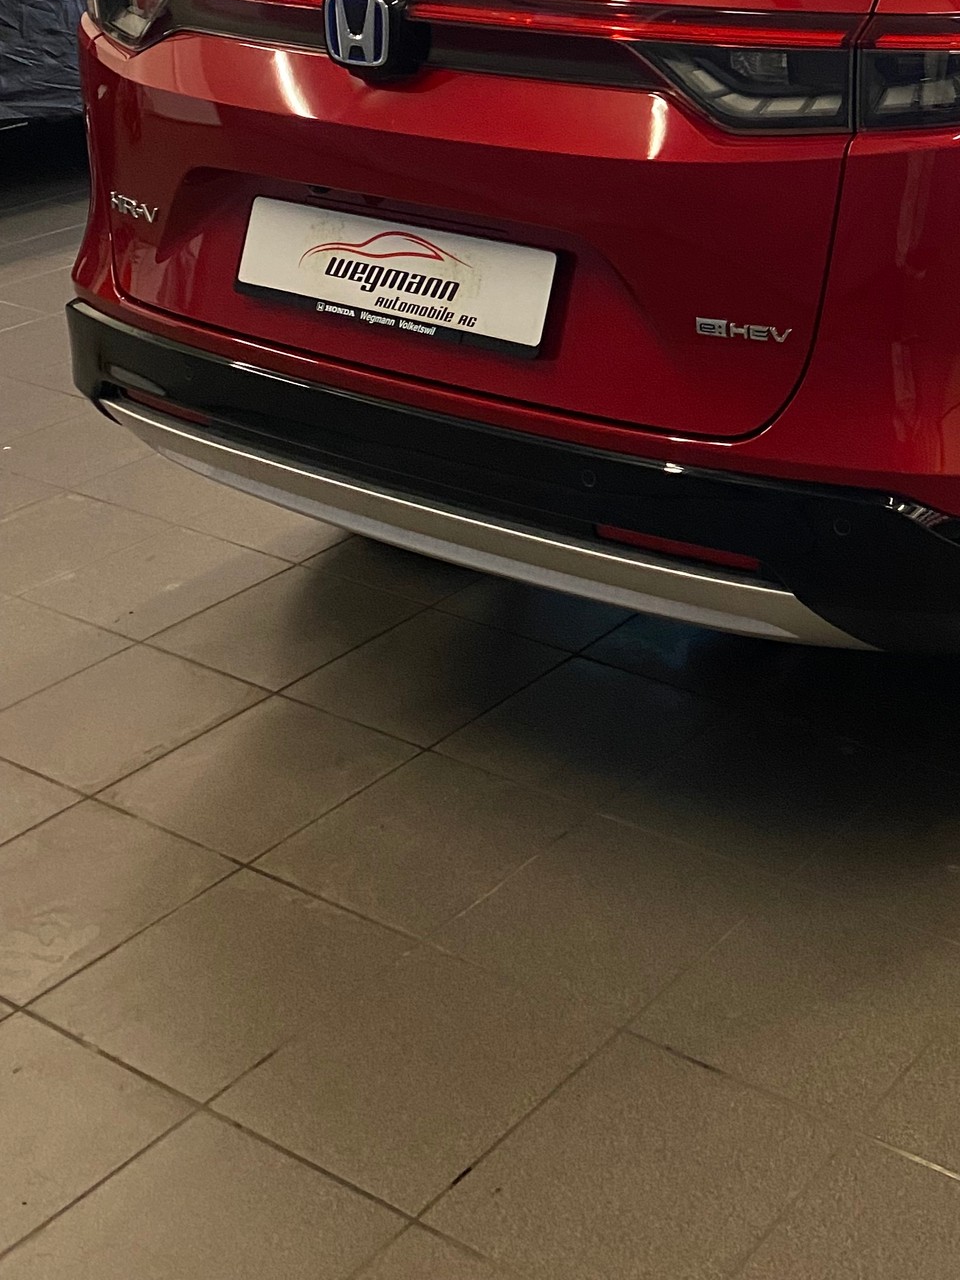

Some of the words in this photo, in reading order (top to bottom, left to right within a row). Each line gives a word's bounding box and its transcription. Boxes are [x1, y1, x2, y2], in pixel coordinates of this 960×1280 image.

[110, 191, 159, 223] HR-V
[325, 257, 460, 301] wegmann
[325, 304, 356, 318] HONDA
[360, 311, 395, 326] Wegmann
[399, 319, 436, 336] Volketswil
[458, 314, 478, 328] AG
